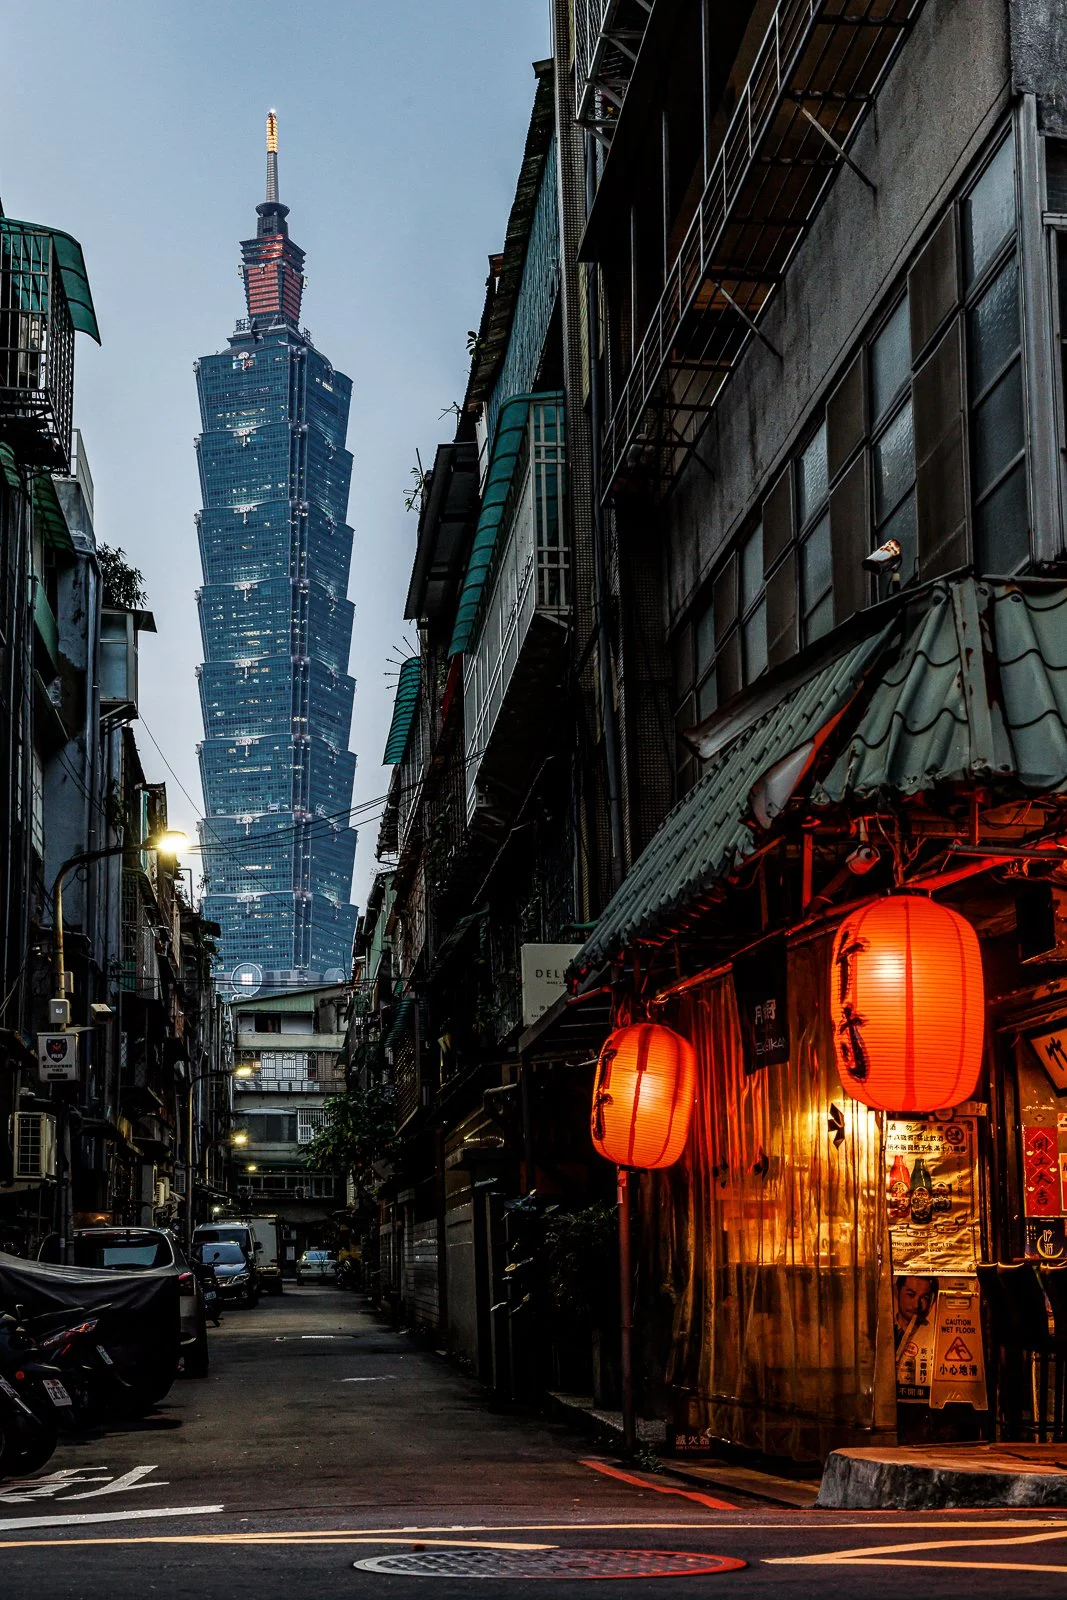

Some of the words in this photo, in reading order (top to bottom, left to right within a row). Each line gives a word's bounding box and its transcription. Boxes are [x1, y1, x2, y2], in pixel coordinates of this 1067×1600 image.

[945, 1318, 972, 1326] CAUTION
[941, 1325, 954, 1333] WET
[955, 1326, 976, 1334] FLOOR
[939, 1364, 978, 1377] 小心地滑
